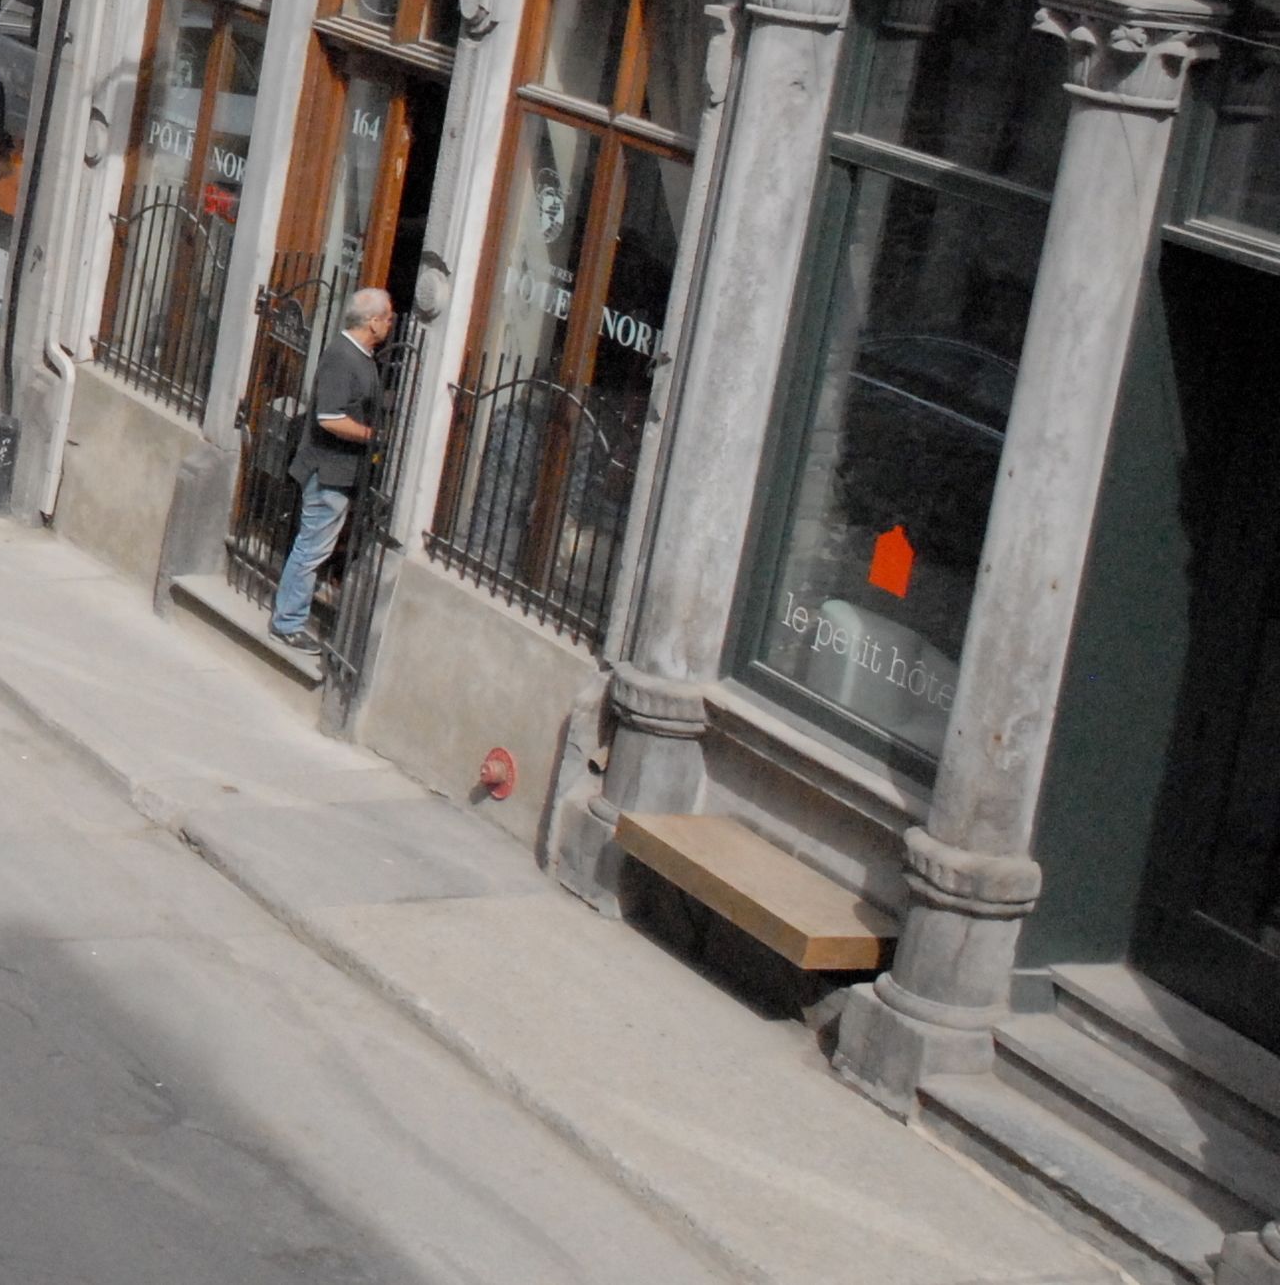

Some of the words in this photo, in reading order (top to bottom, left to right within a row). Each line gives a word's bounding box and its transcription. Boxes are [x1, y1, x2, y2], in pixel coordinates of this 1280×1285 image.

[351, 108, 381, 142] 164
[781, 591, 809, 633] le
[810, 616, 882, 674] petit
